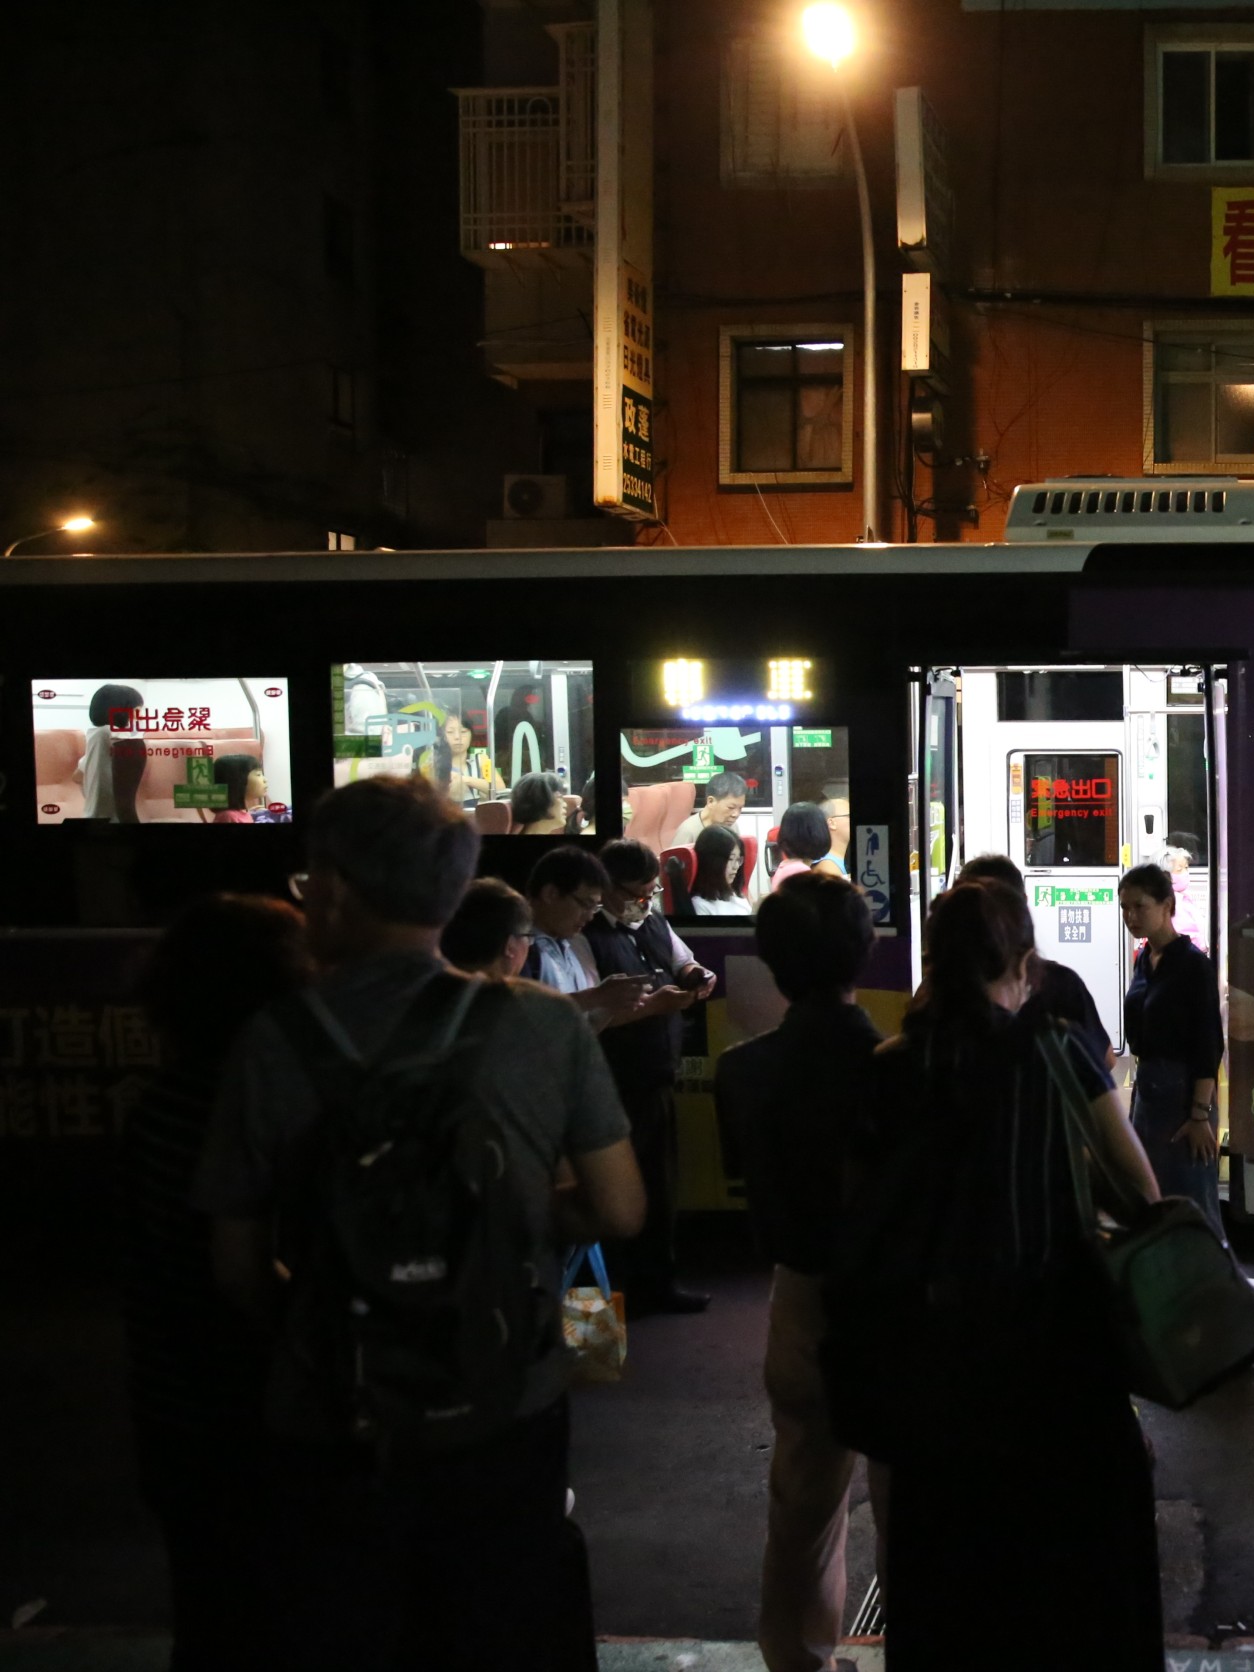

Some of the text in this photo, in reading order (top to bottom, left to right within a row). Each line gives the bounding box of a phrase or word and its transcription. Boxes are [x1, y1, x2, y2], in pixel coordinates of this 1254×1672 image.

[1031, 778, 1112, 799] 緊急出口
[1031, 808, 1113, 819] Emergency exit
[1064, 925, 1087, 941] 安全門
